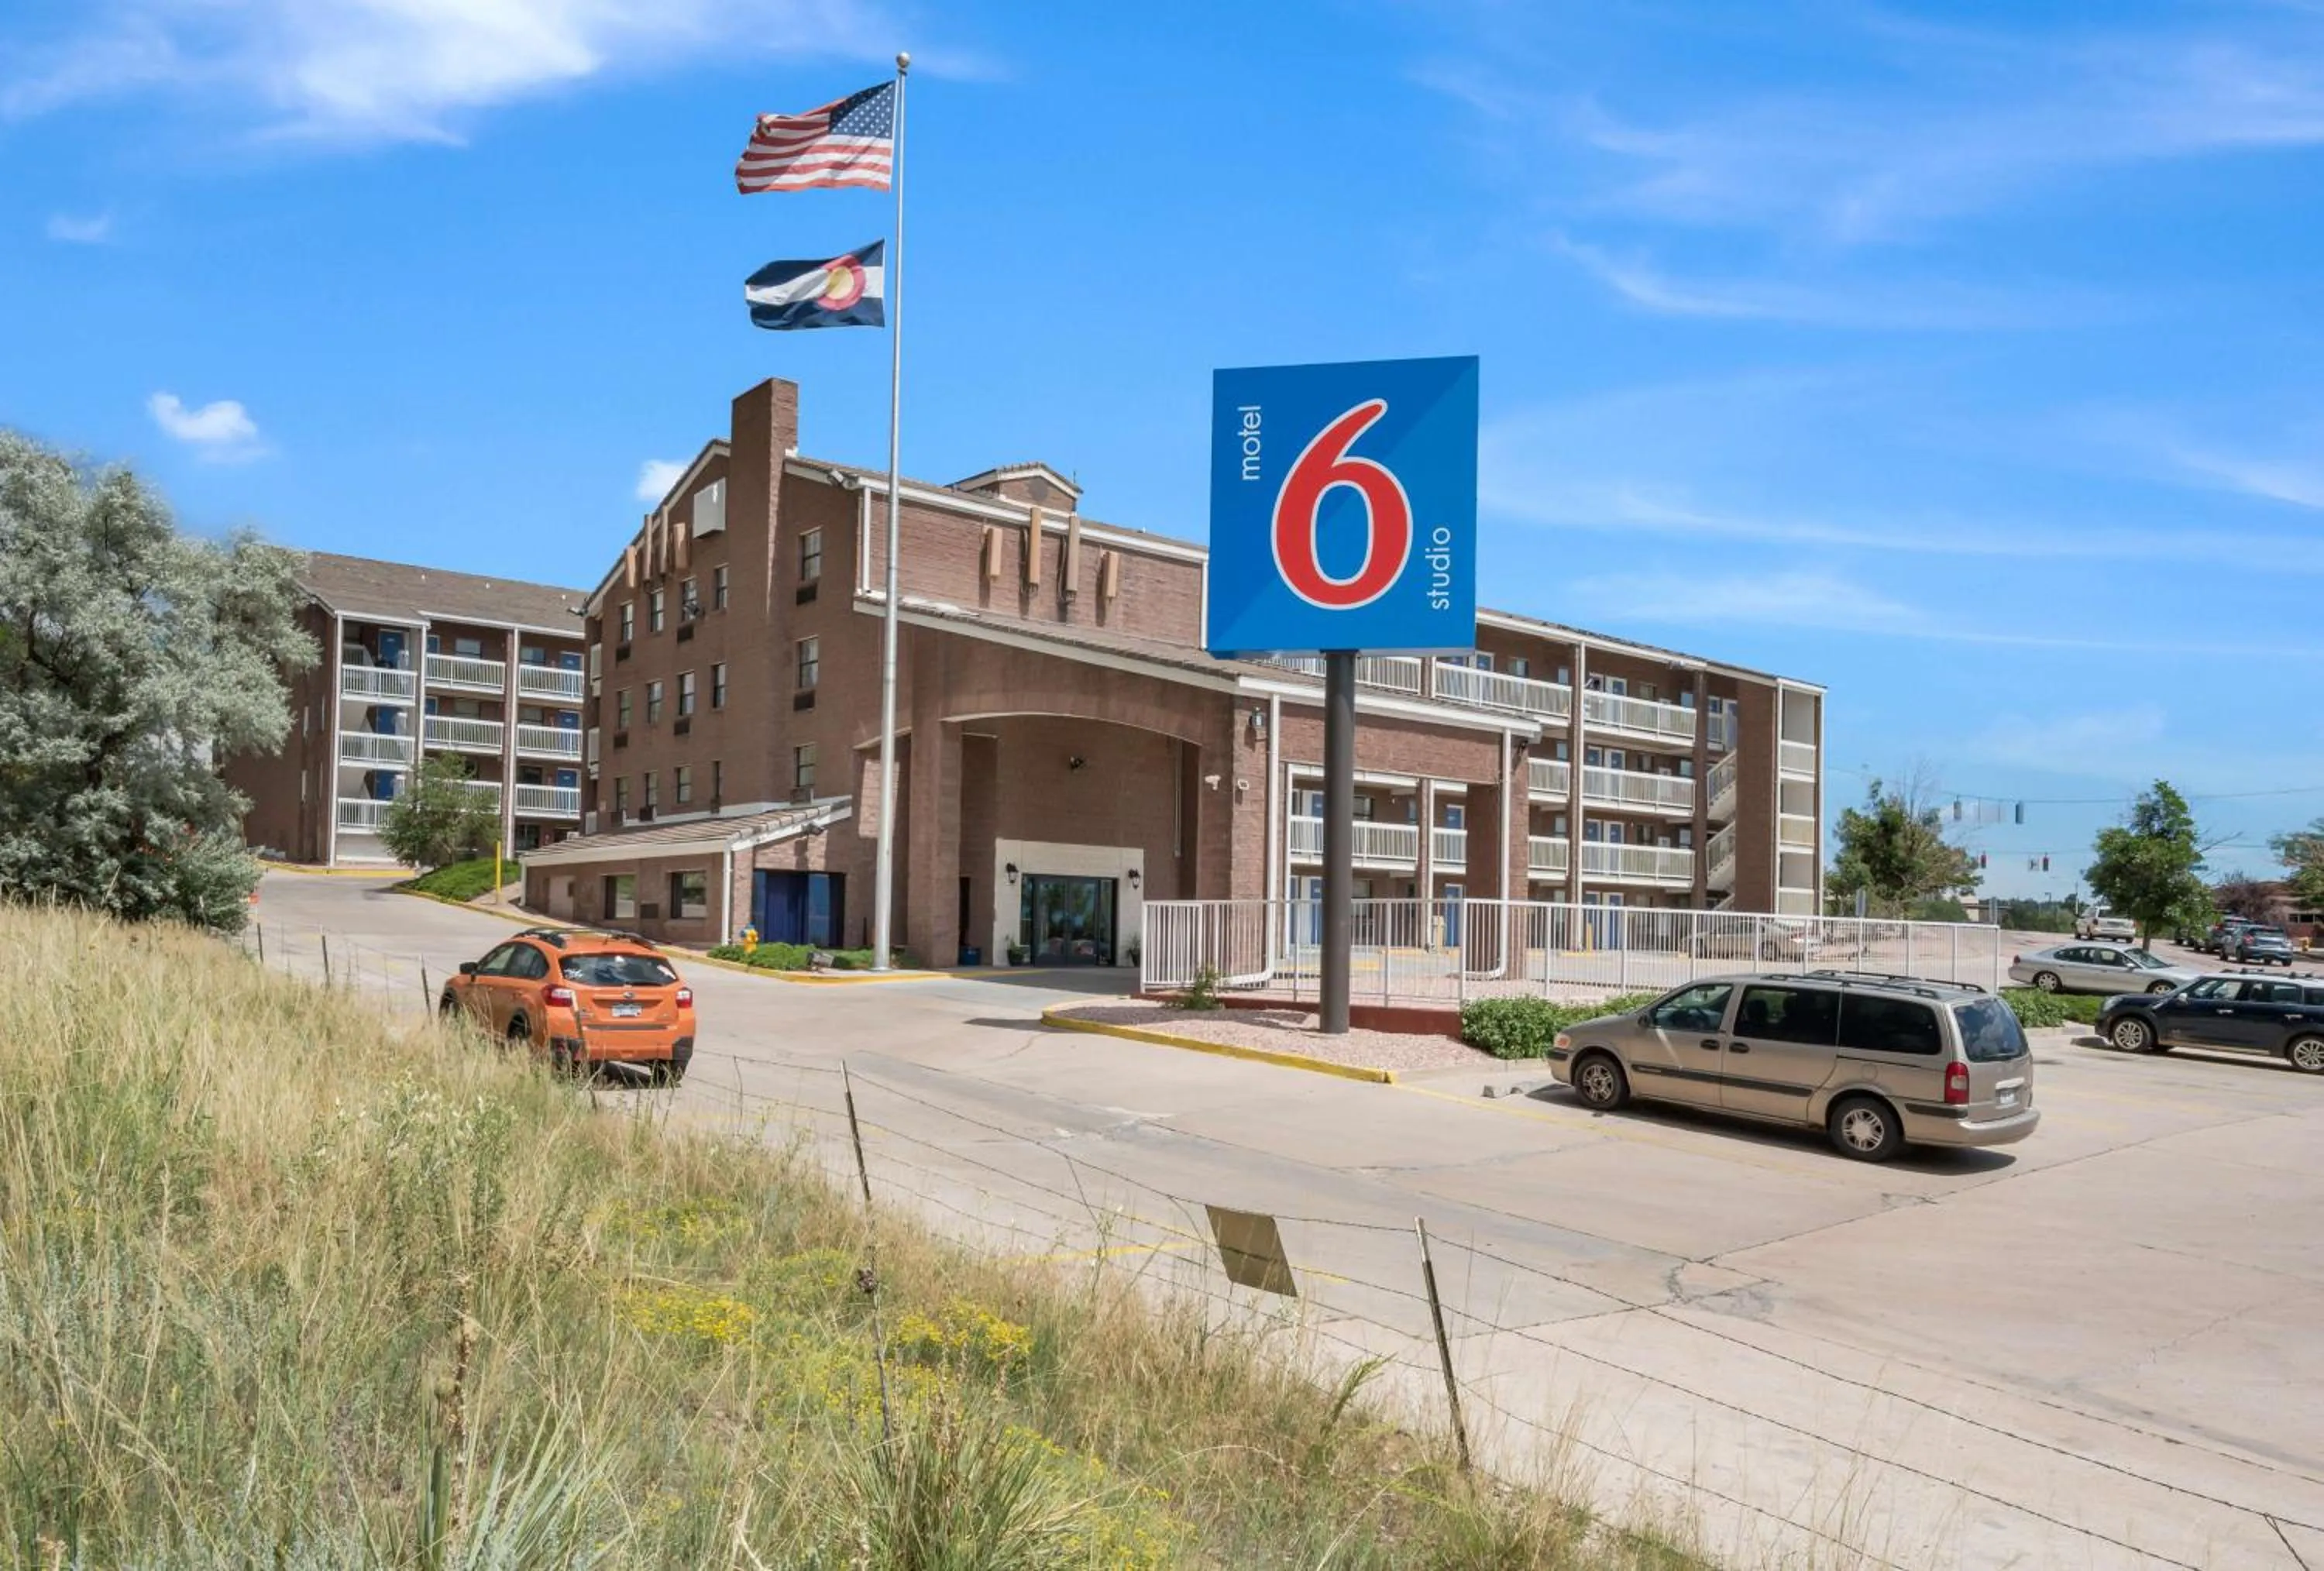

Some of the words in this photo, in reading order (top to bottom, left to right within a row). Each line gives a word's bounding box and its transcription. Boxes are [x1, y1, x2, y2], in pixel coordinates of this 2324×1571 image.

[1238, 405, 1261, 480] motel
[1270, 398, 1414, 610] 6
[1425, 527, 1451, 610] studio
